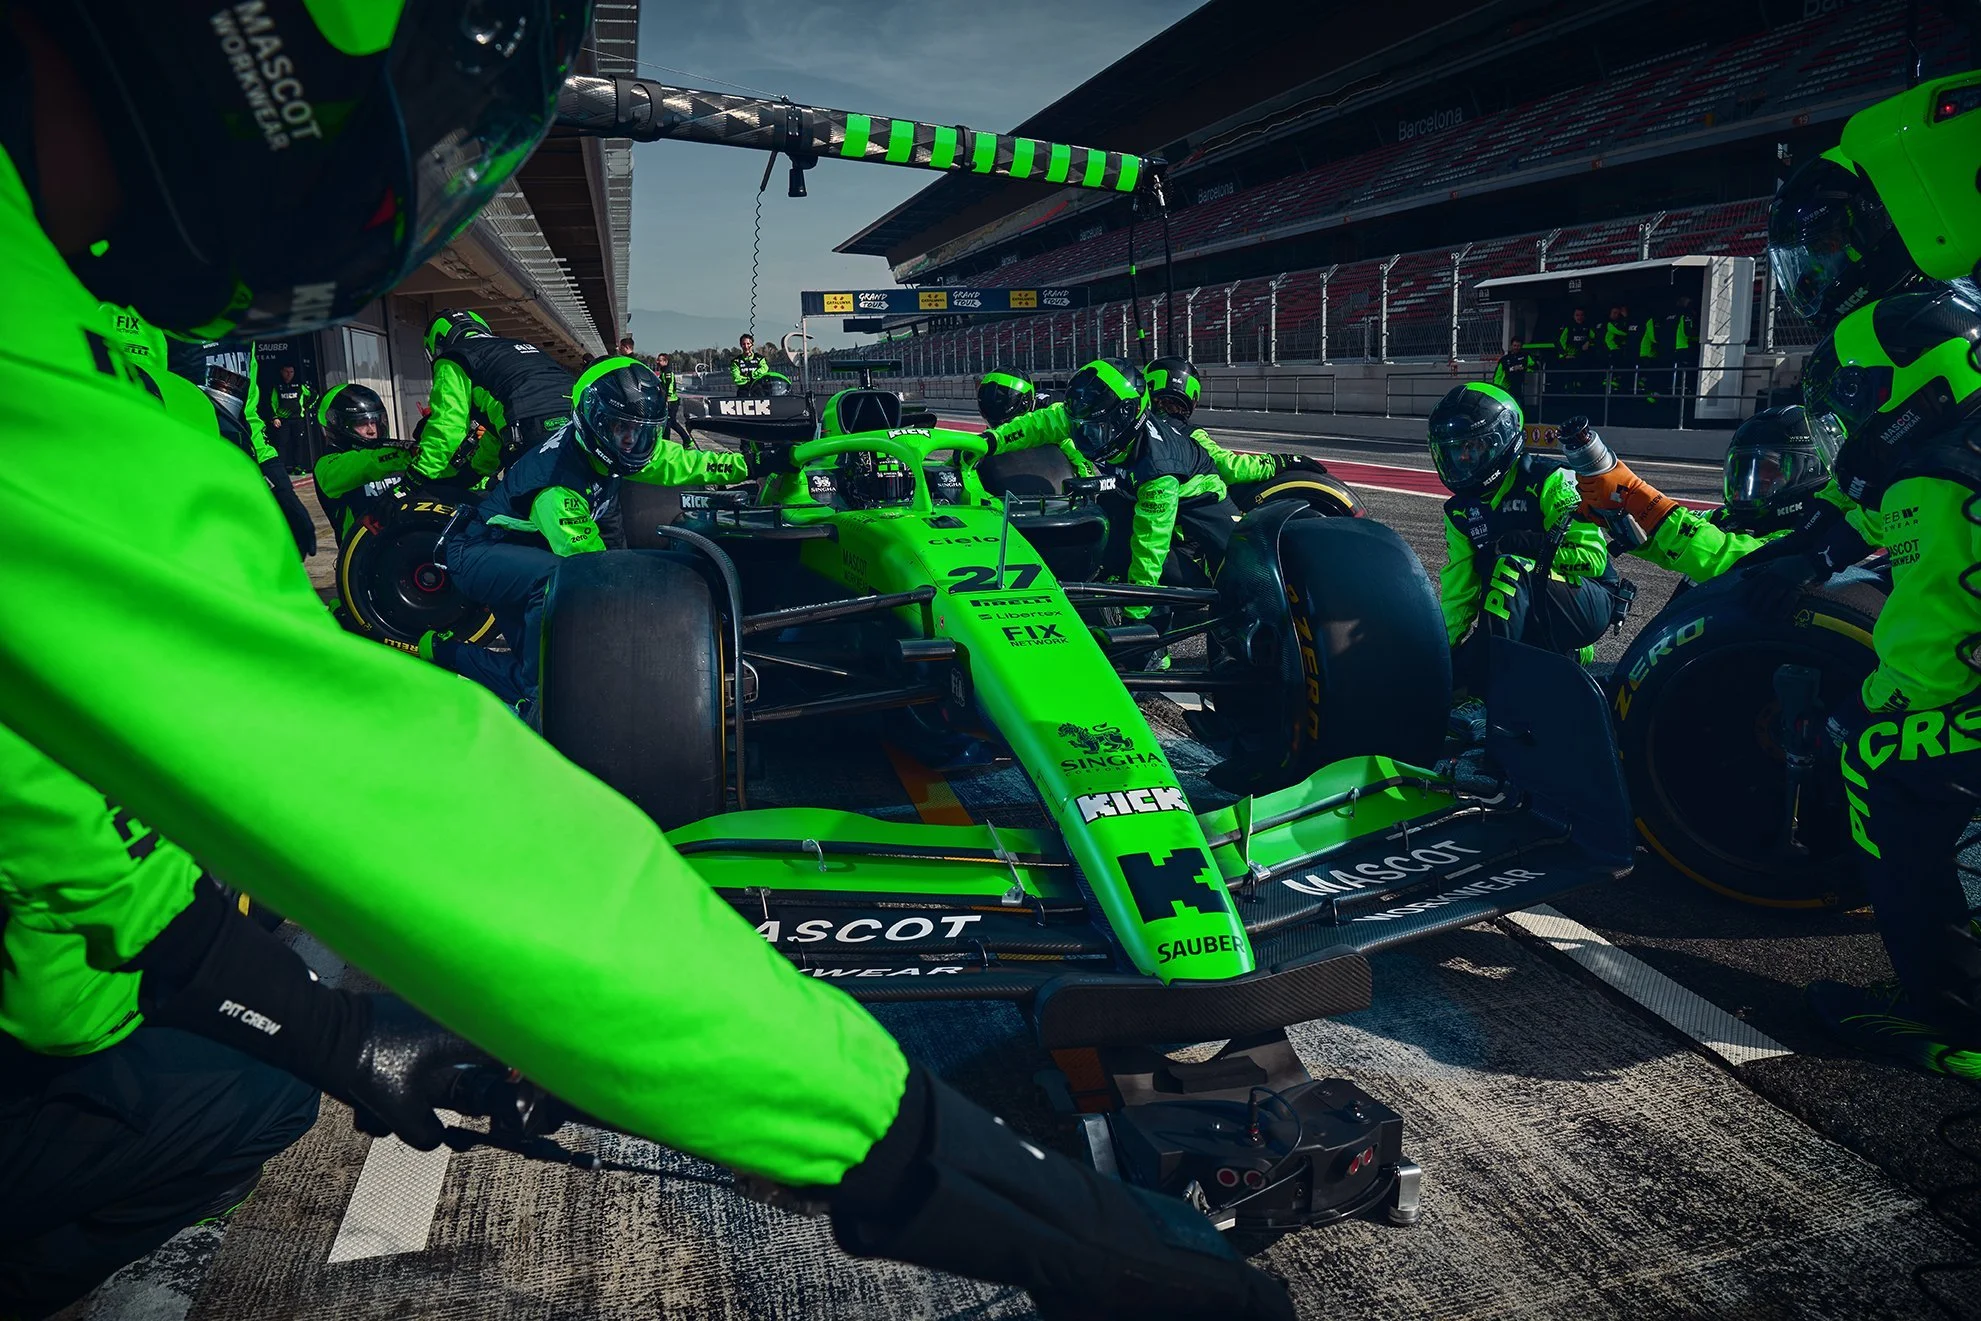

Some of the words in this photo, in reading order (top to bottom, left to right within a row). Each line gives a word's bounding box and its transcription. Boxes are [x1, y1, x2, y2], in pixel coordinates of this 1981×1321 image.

[233, 0, 322, 139] MASCOT
[210, 9, 290, 151] WORKWEAR
[1398, 106, 1464, 141] Barcelona
[1199, 181, 1234, 204] Barcelona
[859, 293, 888, 301] GRAND
[953, 291, 980, 299] GRAND
[1046, 298, 1067, 306] TOUR
[117, 315, 140, 330] FIX
[258, 343, 288, 352] SAUBER
[720, 400, 771, 416] KICK
[887, 428, 931, 439] KICK
[1880, 409, 1915, 441] MASCOT
[1887, 415, 1921, 445] WORKWEAR
[1004, 430, 1025, 445] KICK
[706, 462, 733, 474] KICK
[1484, 469, 1502, 487] KICK
[564, 498, 580, 508] FIX
[682, 496, 711, 508] KICK
[1773, 502, 1803, 517] KICK
[928, 535, 1000, 545] cielo
[1887, 538, 1920, 556] ASCOT
[1559, 563, 1591, 572] KICK
[948, 564, 1043, 594] 27
[1484, 557, 1521, 621] PIT
[969, 596, 1053, 607] PIRELLI
[995, 609, 1064, 620] Libertex
[1002, 624, 1066, 641] FIX
[384, 637, 419, 653] RELLI
[1010, 637, 1069, 648] NETWORK
[1614, 616, 1706, 721] ZERO
[1293, 616, 1320, 740] ZERO
[1060, 752, 1164, 773] SINGHA
[1065, 763, 1168, 777] CORPORATION
[1076, 786, 1191, 823] KICK
[1282, 840, 1482, 896] MASCOT
[1352, 868, 1546, 922] WORKWEAR
[753, 914, 982, 943] ASCOT
[1157, 934, 1246, 964] SAUBER
[218, 1000, 241, 1018] PIT
[240, 1008, 282, 1036] CREW
